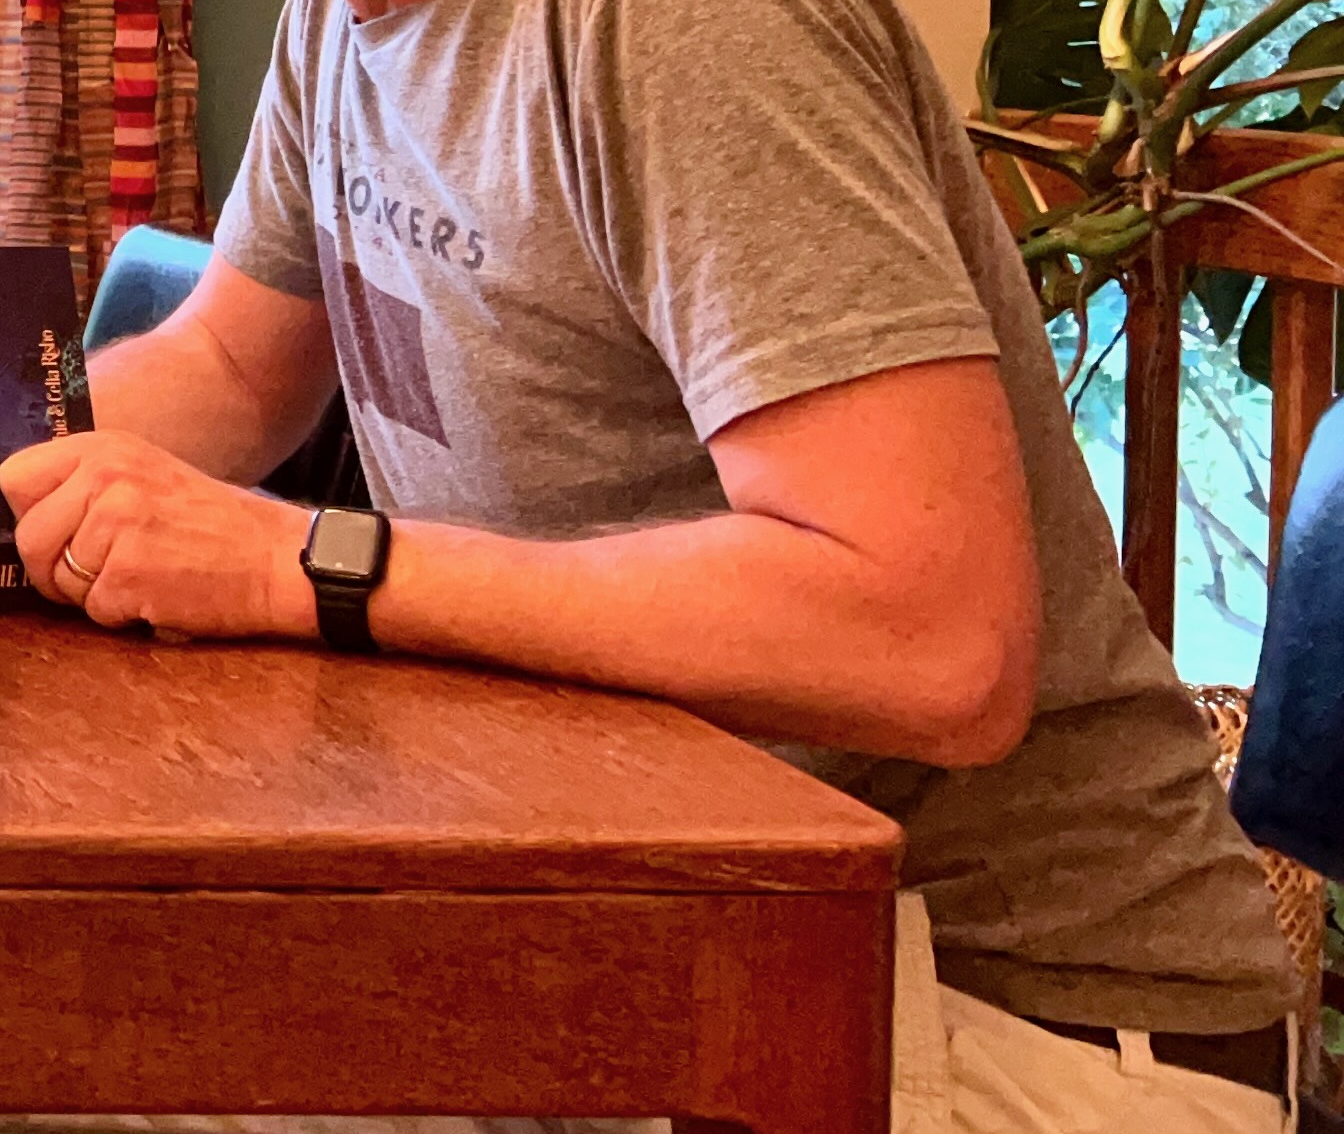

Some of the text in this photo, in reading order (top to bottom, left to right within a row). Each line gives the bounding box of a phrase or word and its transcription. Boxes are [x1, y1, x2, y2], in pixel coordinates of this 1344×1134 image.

[346, 175, 487, 269] OKERS
[38, 329, 61, 366] Risho
[45, 369, 63, 402] Celia
[47, 405, 66, 417] &
